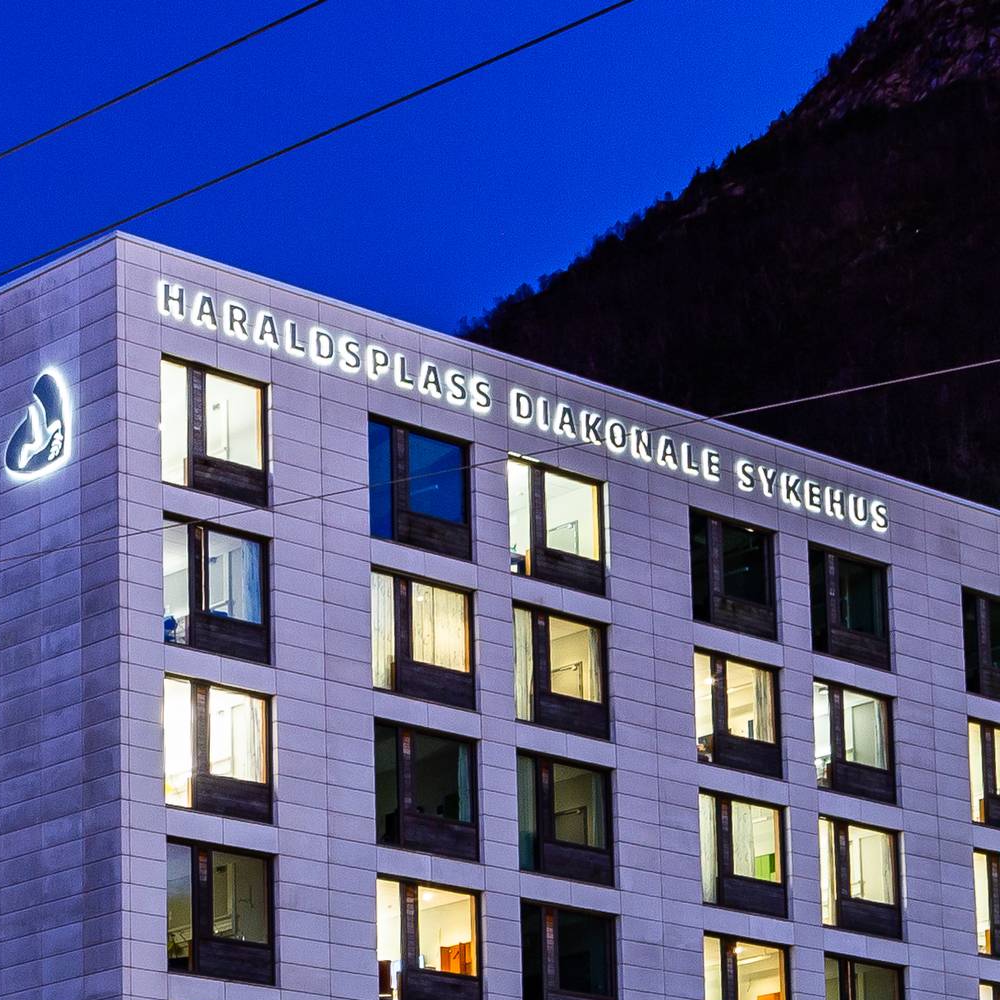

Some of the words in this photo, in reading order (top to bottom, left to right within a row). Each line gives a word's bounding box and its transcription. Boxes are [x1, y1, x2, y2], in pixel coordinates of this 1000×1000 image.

[157, 279, 493, 413] HARALDSPLASS
[510, 388, 722, 482] DIAKONALE
[735, 459, 889, 532] SYKEHUS
